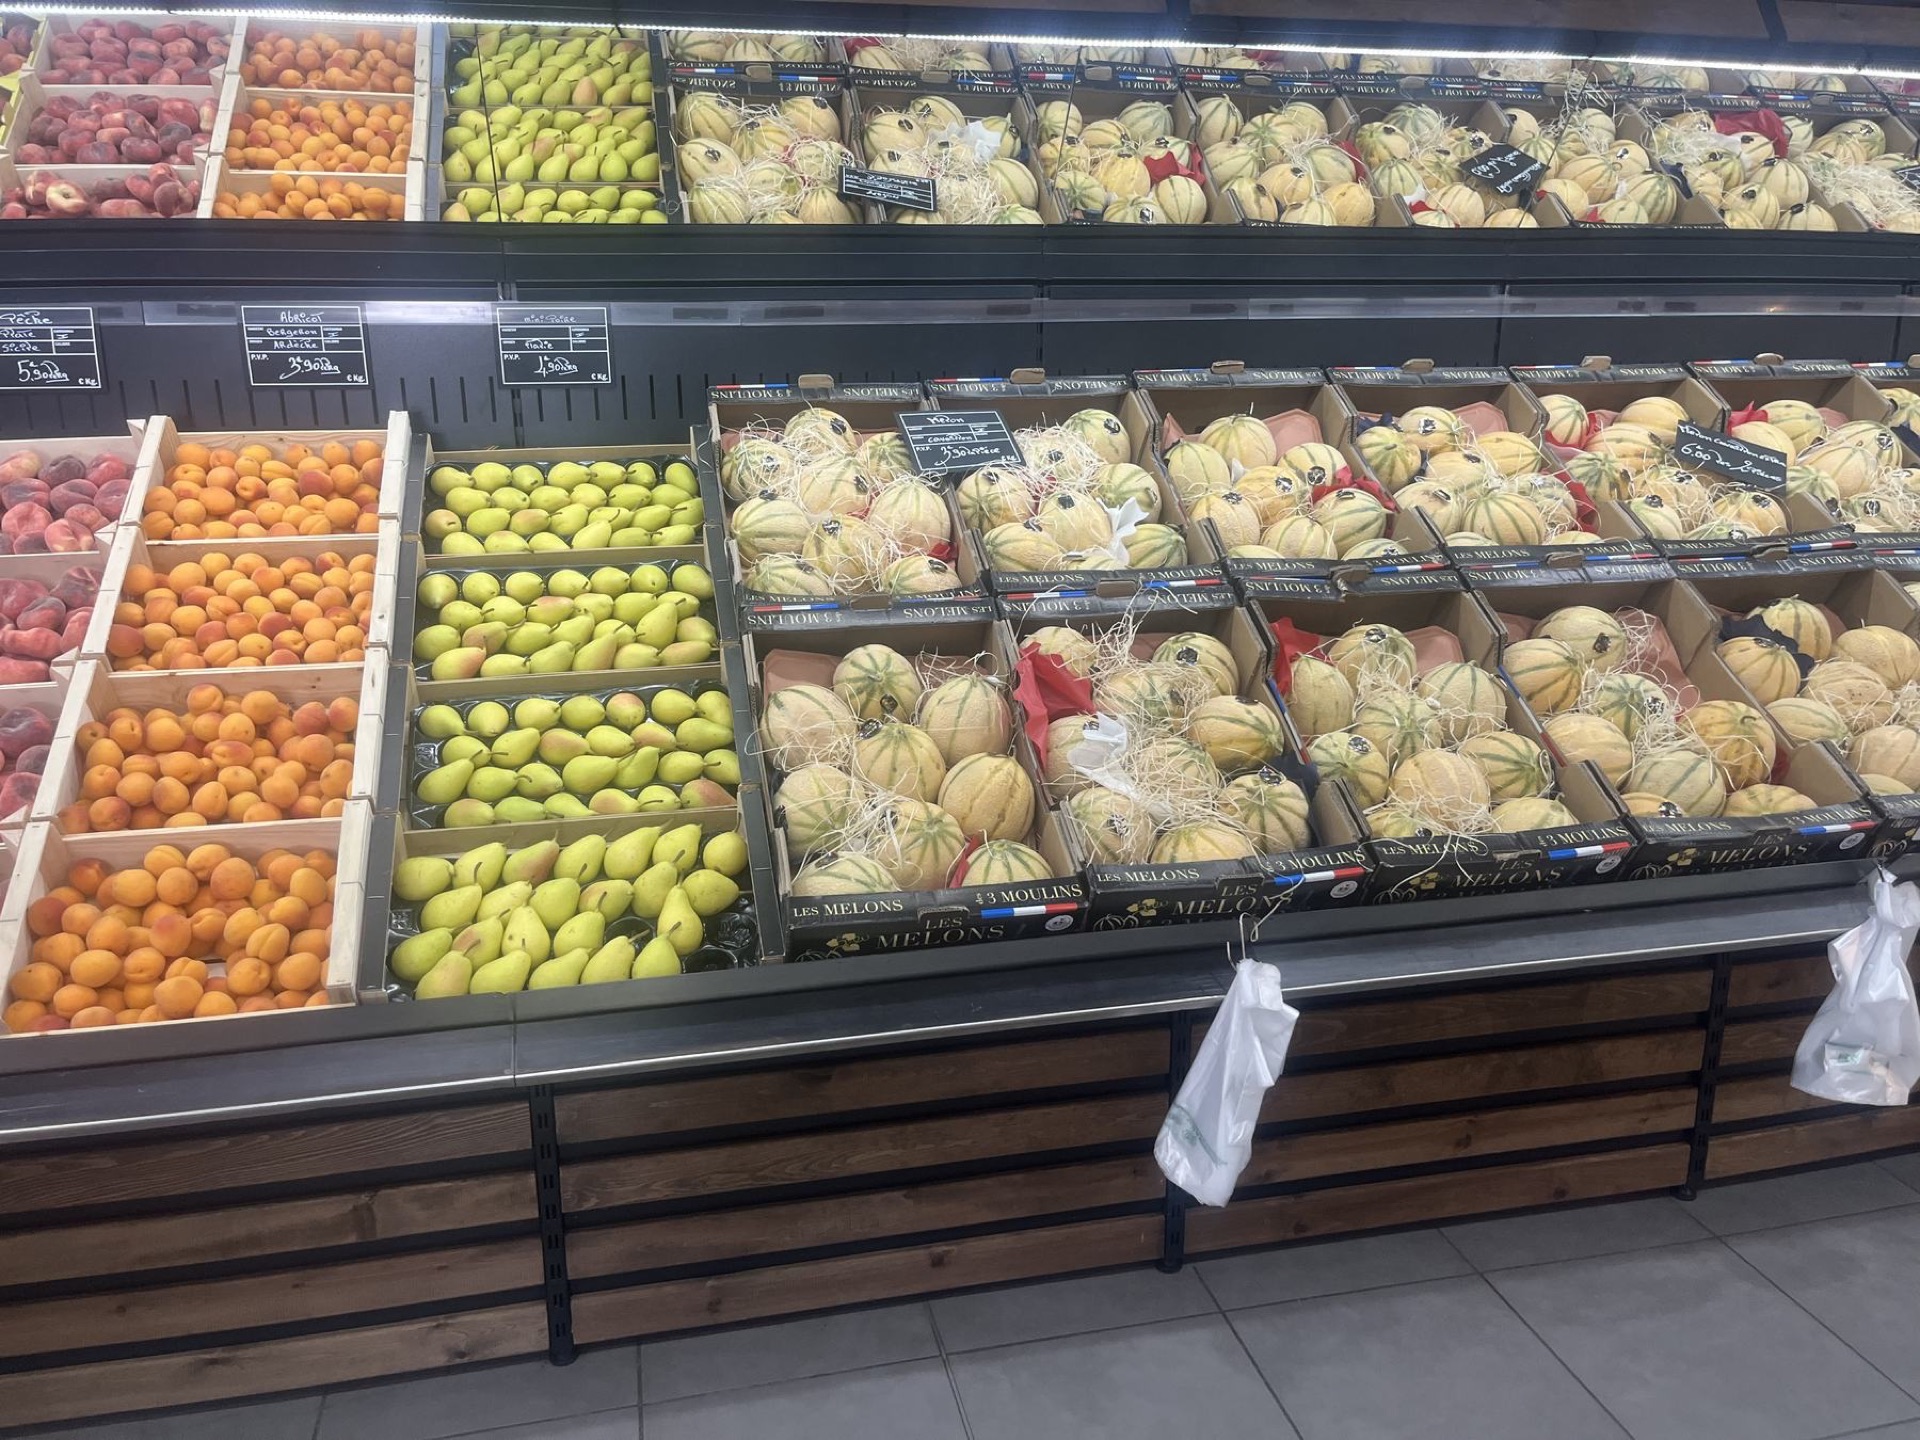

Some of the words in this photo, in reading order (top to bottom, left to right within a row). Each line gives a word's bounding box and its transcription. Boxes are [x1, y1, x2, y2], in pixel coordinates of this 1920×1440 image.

[1256, 561, 1315, 570] MELONS
[1022, 573, 1085, 583] MELONS
[1157, 566, 1223, 579] MOULINS
[747, 612, 820, 625] MOULINS
[903, 606, 968, 618] MELONS
[1665, 820, 1732, 833] MELONS
[1546, 834, 1557, 846] 3
[1557, 826, 1629, 844] MOULINS
[1276, 860, 1286, 871] 3
[1288, 849, 1366, 870] MOULINS
[1097, 873, 1121, 882] LES
[1123, 867, 1200, 882] MELONS
[987, 892, 997, 905] 3
[1000, 884, 1083, 903] MOULINS
[1221, 884, 1257, 897] LES
[794, 906, 819, 917] LES
[824, 899, 904, 916] MELONS
[925, 917, 963, 930] LES
[877, 925, 1004, 948] MELONS
